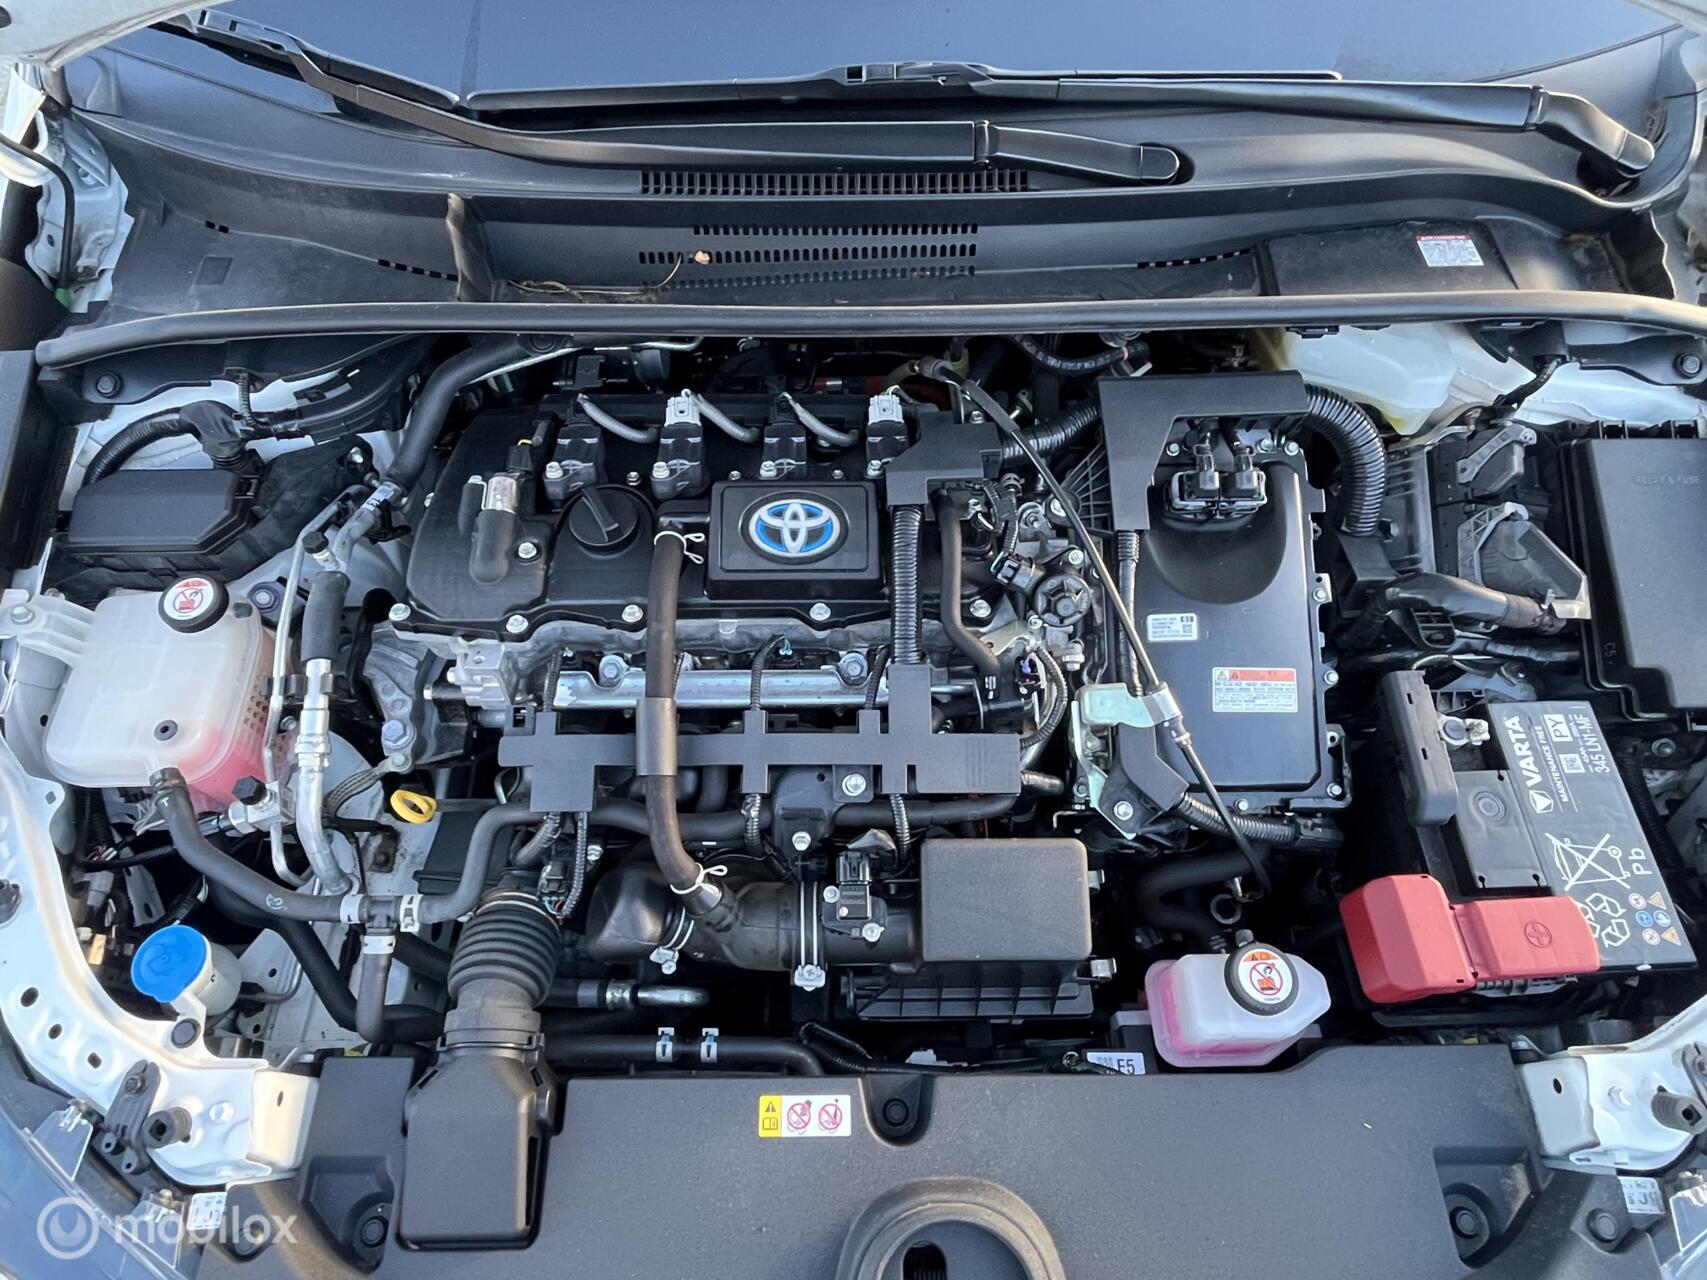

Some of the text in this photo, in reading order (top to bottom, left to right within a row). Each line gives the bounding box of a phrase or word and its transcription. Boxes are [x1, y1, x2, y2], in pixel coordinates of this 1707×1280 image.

[1547, 717, 1569, 738] PY
[1504, 716, 1542, 787] VARTA
[1534, 725, 1568, 802] MAINTENANCE FREE
[1591, 754, 1610, 773] 345
[1628, 848, 1653, 875] Pb
